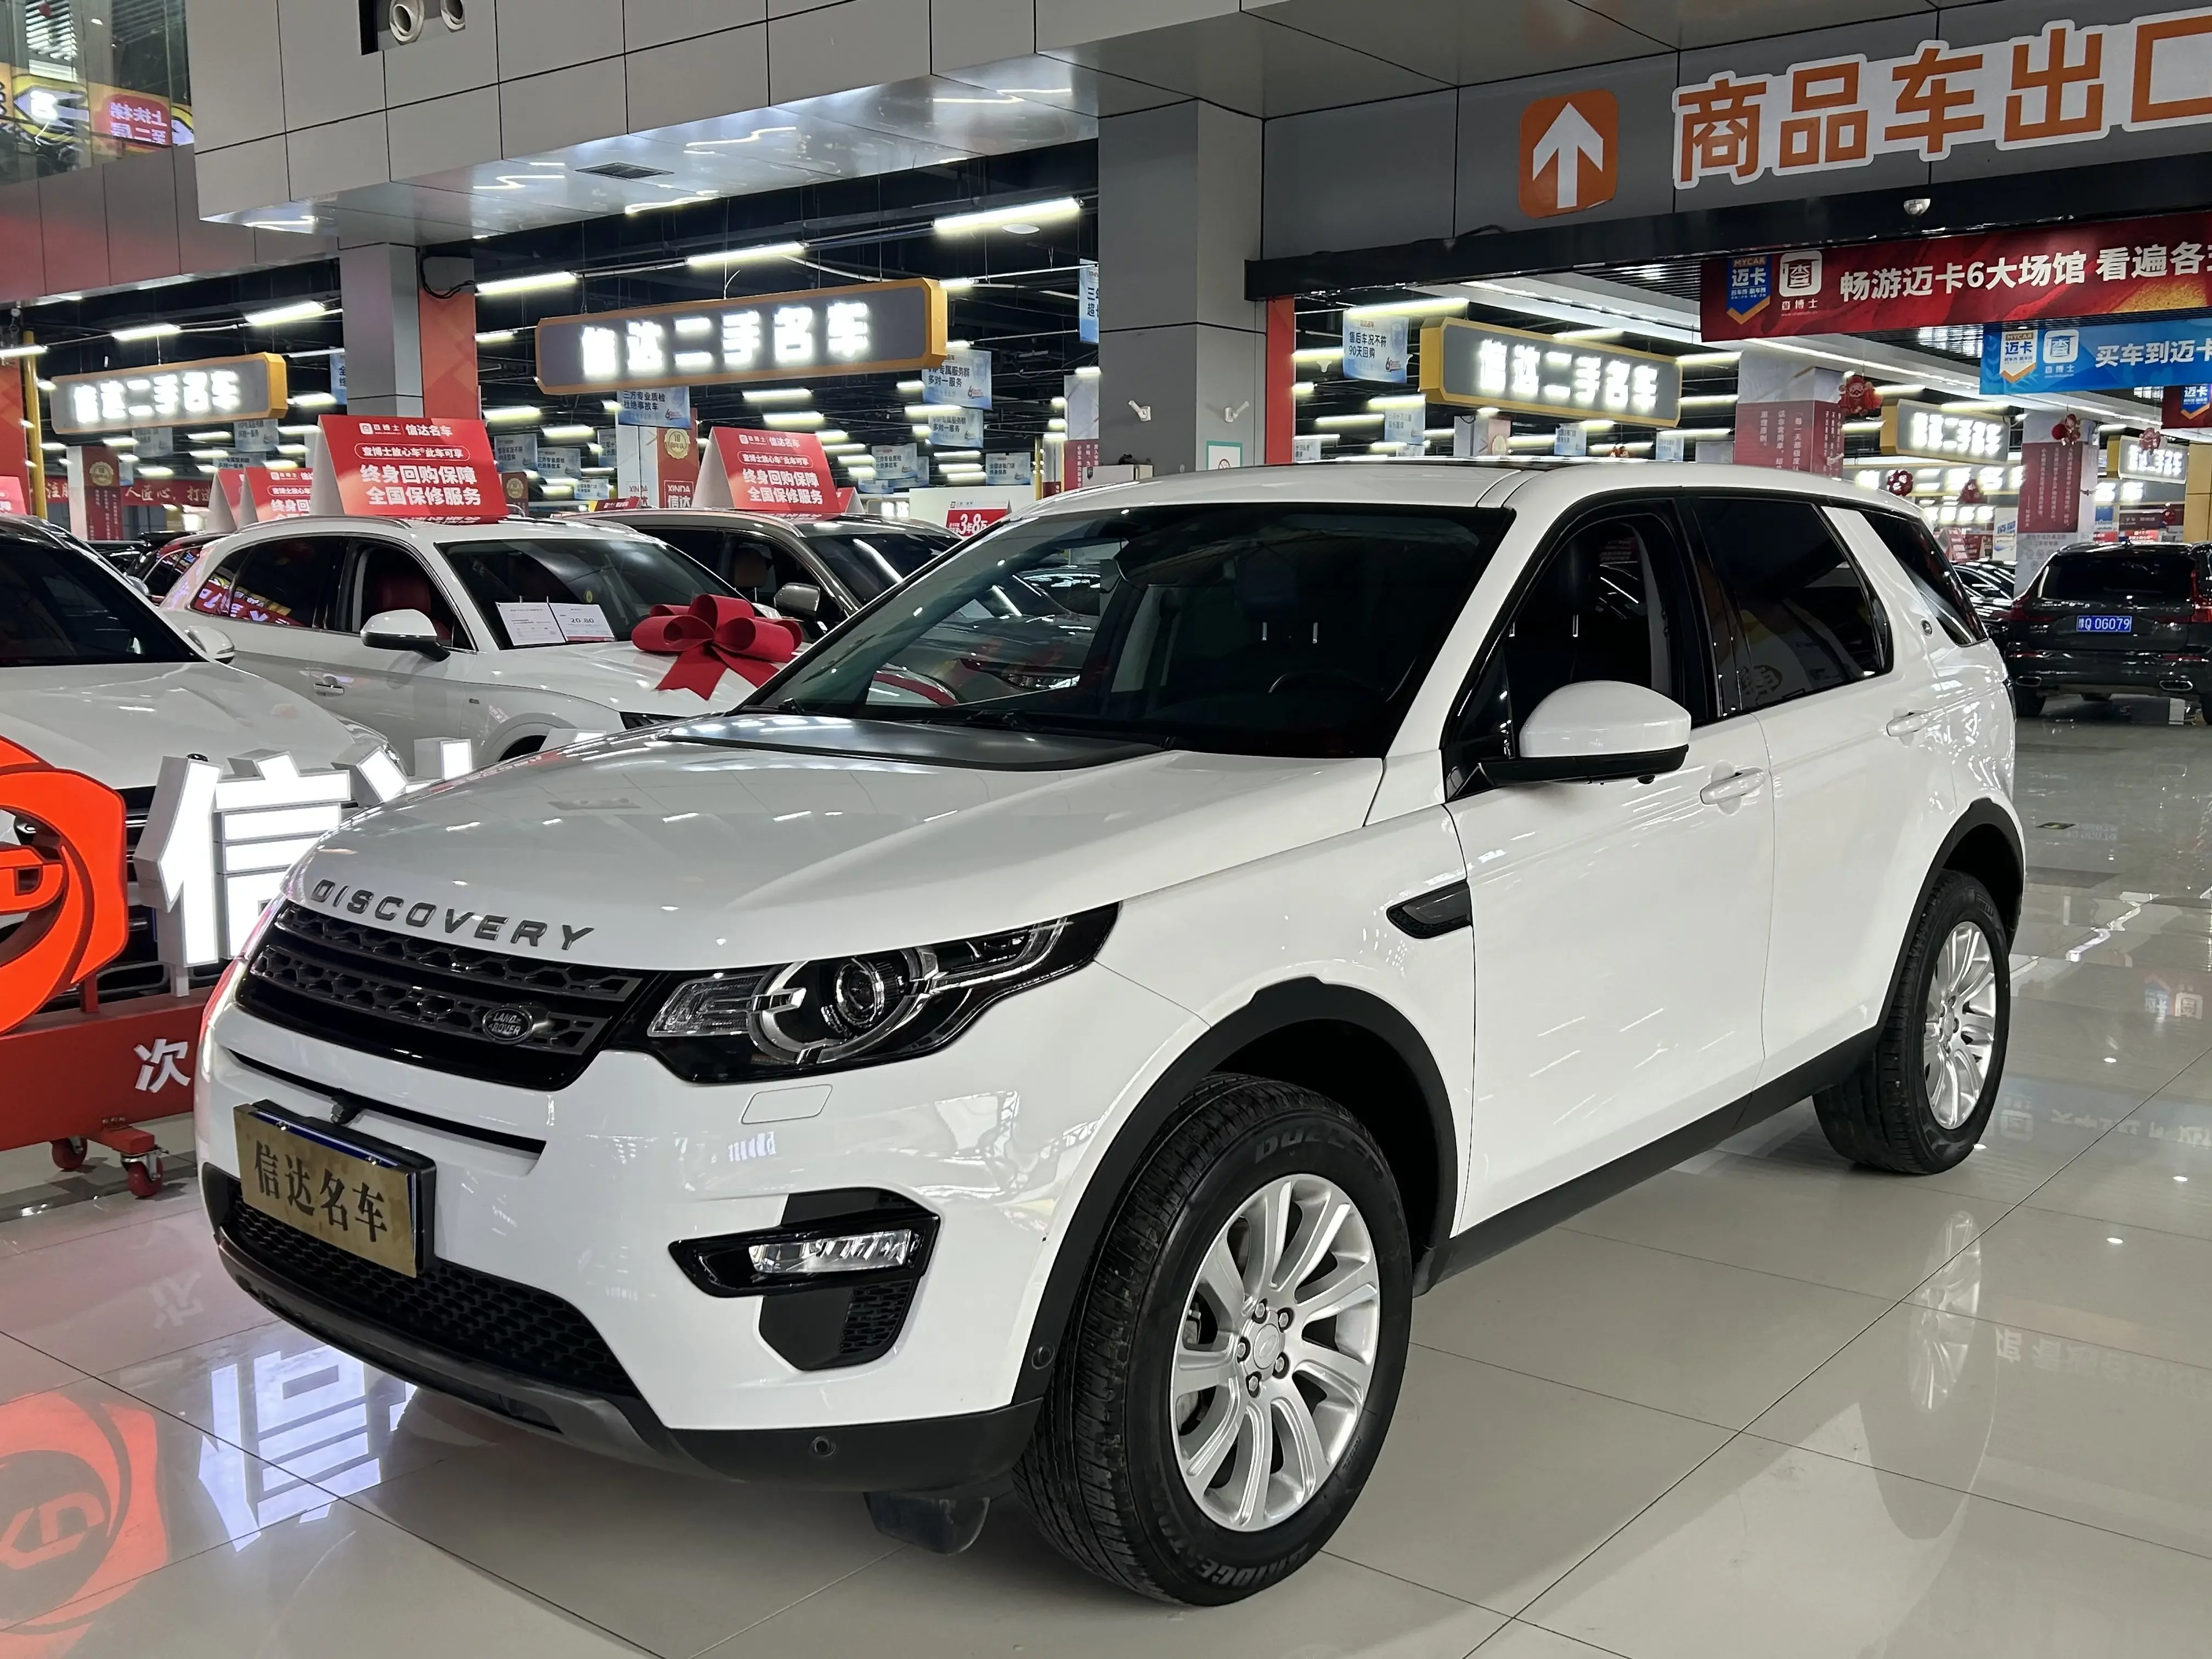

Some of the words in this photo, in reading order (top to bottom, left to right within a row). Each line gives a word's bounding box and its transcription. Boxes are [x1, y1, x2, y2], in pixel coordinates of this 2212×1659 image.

[1678, 15, 2212, 183] 商品车出口
[1732, 267, 1766, 287] 迈卡
[1840, 251, 2087, 302] 畅游迈卡6大场馆
[1781, 298, 1818, 311] 查博士
[1350, 331, 1387, 348] 售后车况不符
[1349, 345, 1375, 359] 90天回购
[2005, 341, 2033, 355] 迈卡
[928, 375, 962, 387] 多对一服务
[623, 391, 665, 402] 三方专业质检
[2184, 386, 2208, 397] 迈卡
[623, 400, 658, 411] 杜绝事故车
[405, 424, 453, 437] 信达名车
[769, 437, 800, 448] 信达名车
[359, 464, 477, 485] 终身回购保障
[742, 468, 820, 488] 终身回购保障
[366, 486, 481, 505] 全国保修服务
[667, 484, 690, 493] XINDA
[747, 486, 823, 505] 全国保修服务
[667, 495, 691, 508] 信达
[311, 879, 595, 950] DISCOVERY
[493, 1012, 517, 1023] LAND
[491, 1022, 521, 1035] ROVER
[133, 1038, 191, 1093] 次
[254, 1139, 387, 1242] 信达名车
